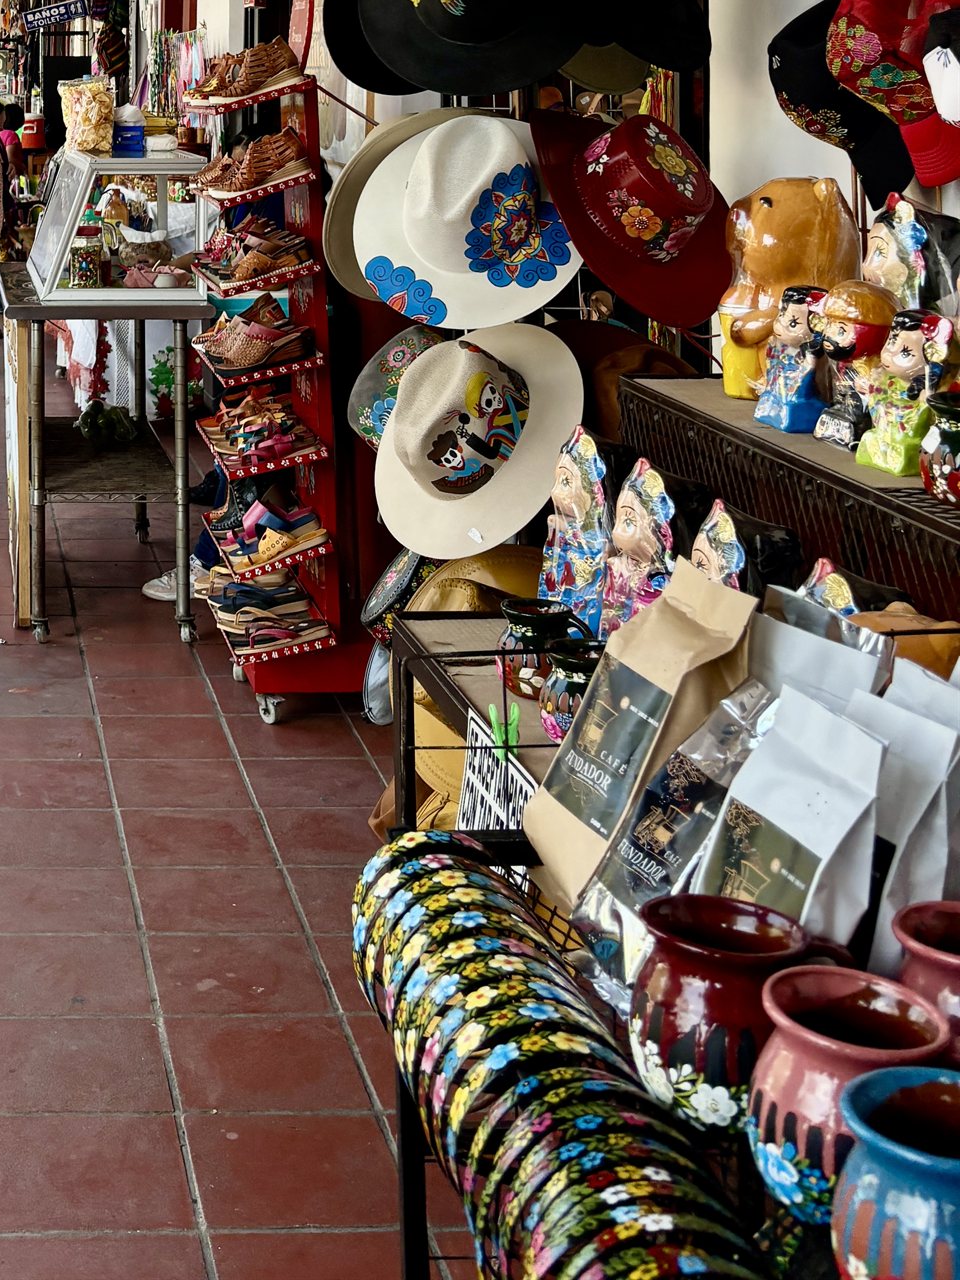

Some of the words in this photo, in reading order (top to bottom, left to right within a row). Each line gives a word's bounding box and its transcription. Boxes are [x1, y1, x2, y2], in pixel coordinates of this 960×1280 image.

[26, 6, 66, 22] BAÑOS
[32, 15, 60, 27] TOILET
[565, 749, 613, 792] FUNDADOR
[600, 750, 628, 775] CAFÉ
[617, 838, 667, 881] FUNDADOR
